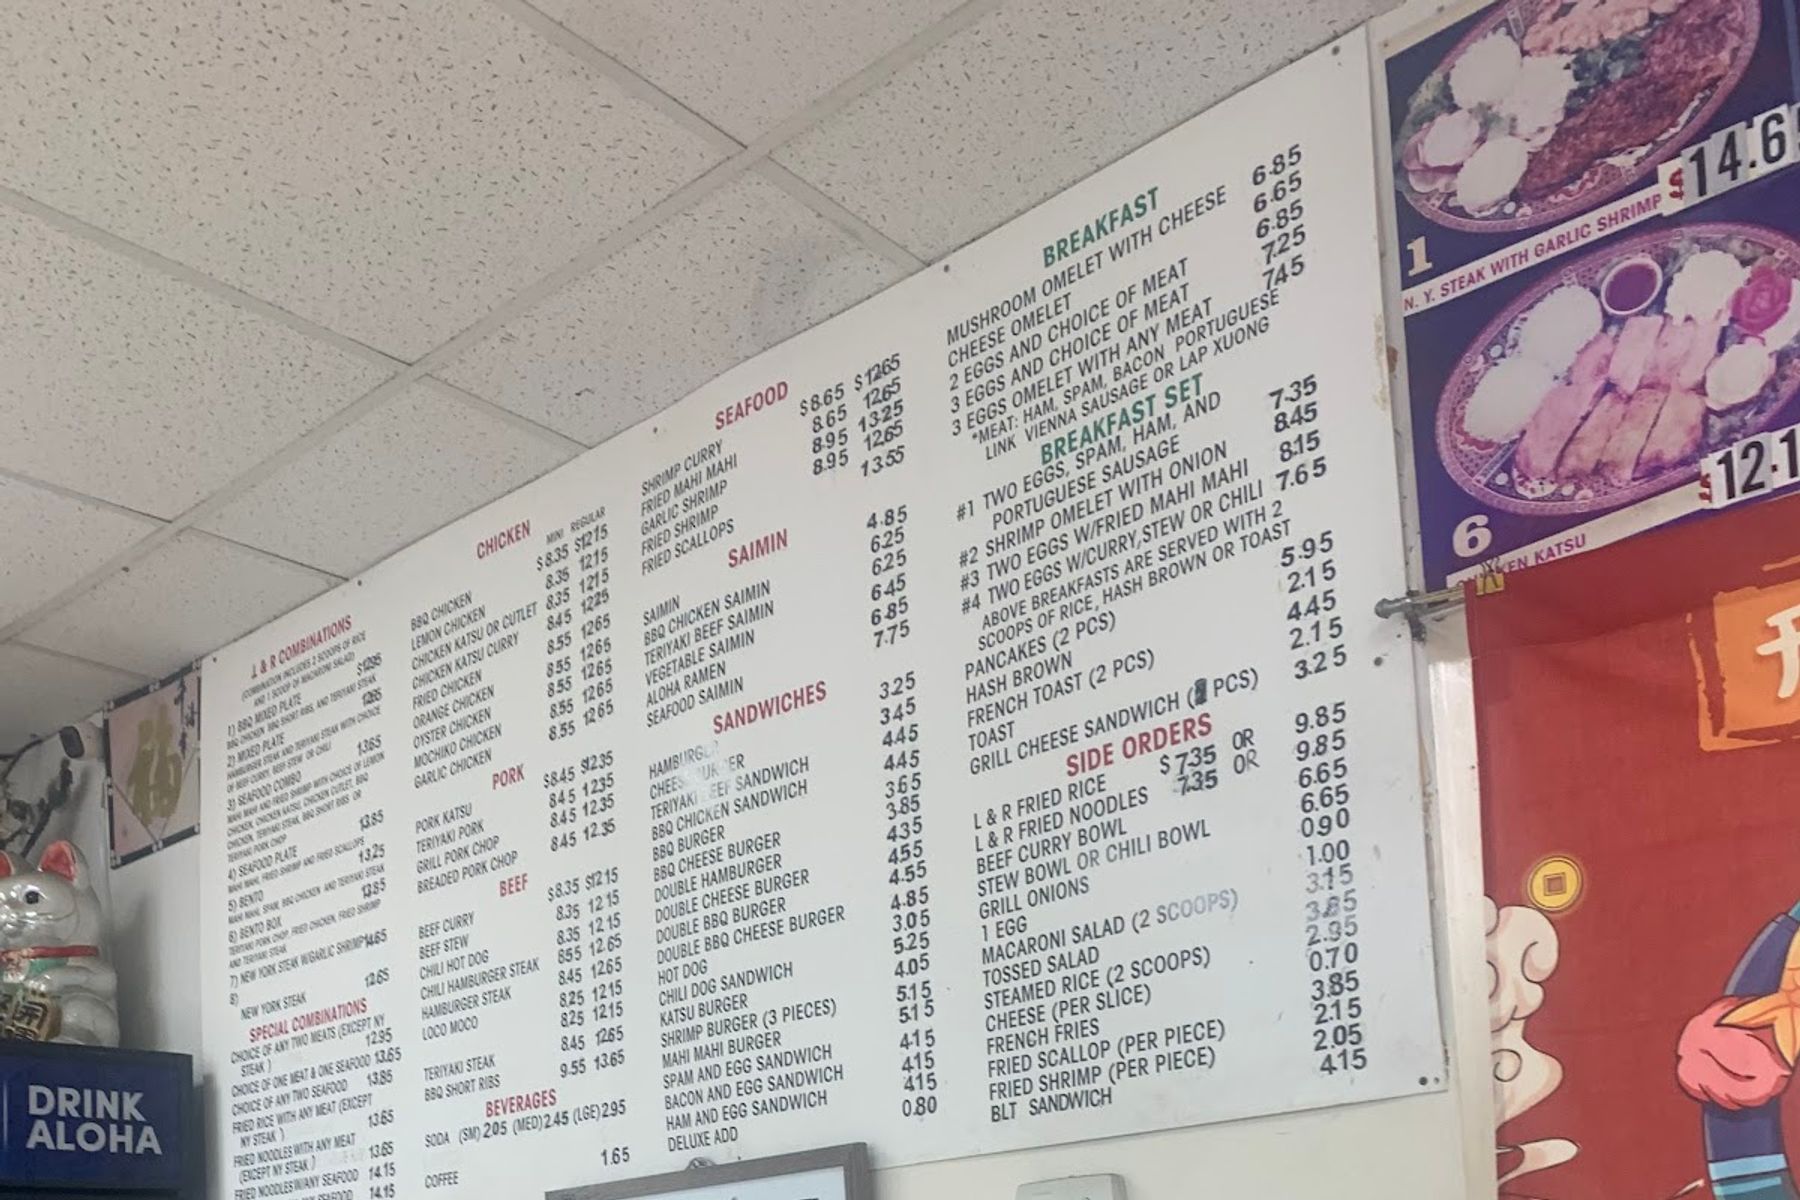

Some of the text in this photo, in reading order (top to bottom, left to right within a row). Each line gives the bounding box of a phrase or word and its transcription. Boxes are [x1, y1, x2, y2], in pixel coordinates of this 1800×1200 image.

[1252, 143, 1302, 186] 6.85
[1669, 105, 1800, 200] $14.6
[1253, 170, 1302, 213] 6.65
[1043, 187, 1158, 268] BREAKFAST
[1256, 199, 1304, 239] 6.85
[946, 184, 1226, 347] MUSHROOM OMELET WITH CHEESE
[1406, 236, 1433, 278] 1
[1440, 266, 1486, 297] STEAK
[1490, 249, 1530, 275] WITH
[1534, 223, 1592, 258] GARLIC
[1596, 193, 1662, 232] SHRIMP
[948, 291, 1070, 369] CHEESE OMELET
[950, 257, 1186, 392] 2 EGGS AND CHOICE OF MEAT
[714, 381, 788, 430] SEAFOOD
[1040, 370, 1202, 466] BREAKFAST SET
[476, 519, 530, 560] CHICKEN
[642, 516, 734, 575] FRIED SCALLOPS
[960, 457, 1248, 592] #3 TWO EGGS W/FRIED MAHI MAHI
[1453, 514, 1493, 558] 6
[728, 528, 788, 569] SAIMIN
[1280, 530, 1334, 567] 5.95
[1534, 533, 1587, 564] KATSU
[1287, 559, 1337, 593] 2.15
[410, 589, 472, 631] BBQ CHICKEN
[644, 577, 770, 645] BBQ CHICKEN SAIMIN
[964, 634, 1046, 680] PANCAKES
[1076, 610, 1116, 643] PCS)
[1289, 616, 1343, 650] 2.15
[644, 626, 756, 685] VEGETABLE SAIMIN
[966, 649, 1072, 704] HASH BROWN
[412, 668, 482, 710] FRIED CHICKEN
[646, 657, 726, 707] ALOHA RAMEN
[966, 690, 1028, 727] FRENCH
[1034, 672, 1082, 705] TOAST
[1112, 648, 1154, 681] PCS)
[712, 680, 826, 734] SANDWICHES
[1295, 701, 1346, 734] 9.85
[1066, 710, 1212, 777] SIDE ORDERS
[492, 763, 524, 789] PORK
[1298, 757, 1347, 788] 6.65
[652, 823, 724, 862] BBQ BURGER
[978, 817, 1211, 897] STEW BOWL OR CHILI BOWL
[1307, 839, 1350, 866] 1.00
[498, 872, 528, 897] BEEF
[654, 866, 810, 922] DOUBLE CHEESE BURGER
[418, 932, 470, 960] BEEF STEW
[1309, 942, 1358, 971] 0.70
[658, 957, 708, 985] HOT DOG
[984, 978, 1056, 1010] STEAMED
[1062, 968, 1100, 994] RICE
[1130, 945, 1210, 980] SCOOPS)
[422, 1014, 478, 1041] LOCO MOCO
[660, 1023, 704, 1047] SHRIMP
[706, 1012, 758, 1038] BURGER
[782, 996, 836, 1024] PIECES)
[986, 982, 1152, 1032] CHEESE (PER SLICE)
[1313, 1023, 1362, 1051] 2.05
[664, 1063, 844, 1110] BACON AND EGG SANDWICH
[988, 1045, 1216, 1100] FRIED SHRIMP (PER PIECE)
[28, 1084, 147, 1122] DRINK
[486, 1088, 556, 1117] BEVERAGES
[990, 1085, 1112, 1122] BLT SANDWICH
[26, 1119, 163, 1156] ALOHA
[668, 1125, 738, 1152] DELUXE ADD
[424, 1170, 458, 1188] COFFEE
